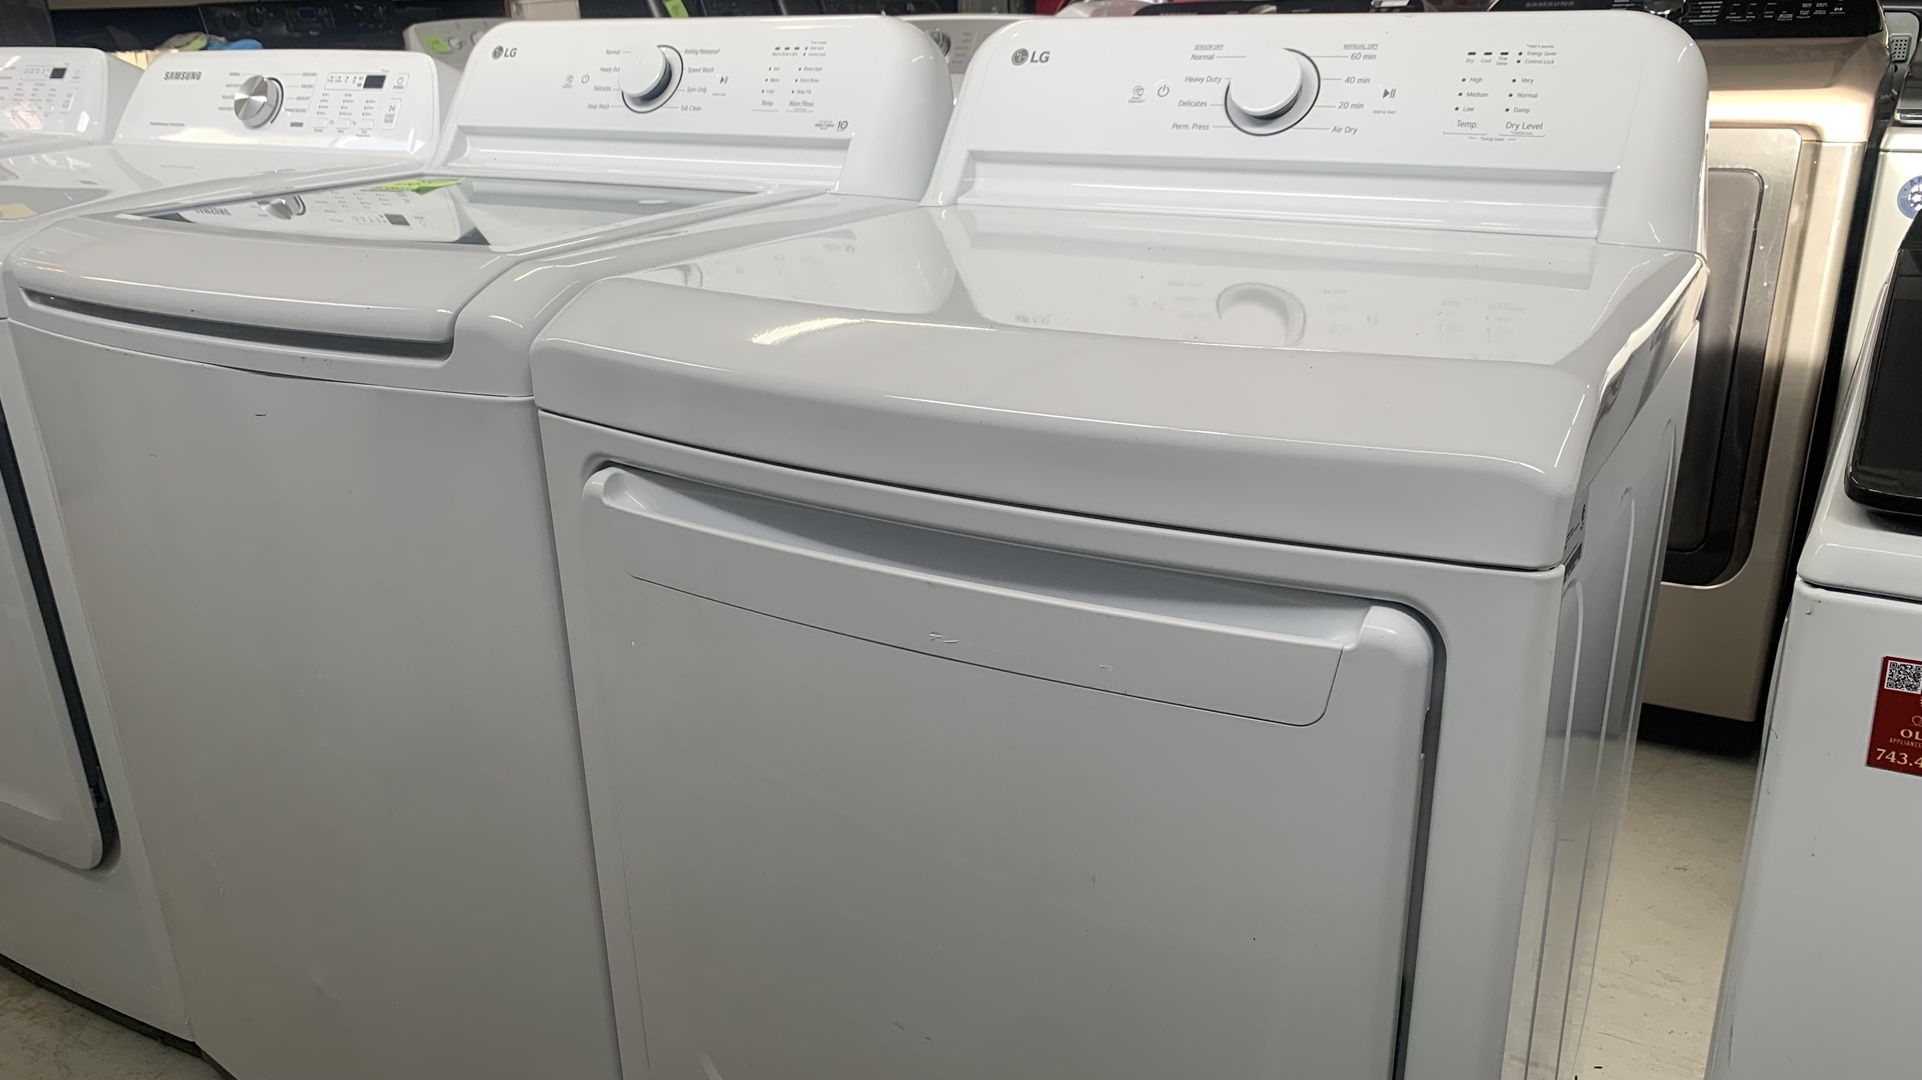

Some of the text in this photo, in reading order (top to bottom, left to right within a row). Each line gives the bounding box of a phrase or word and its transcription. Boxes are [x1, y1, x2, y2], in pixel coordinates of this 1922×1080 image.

[1191, 53, 1215, 61] Normal
[1350, 52, 1362, 60] 60
[163, 71, 202, 81] SAMSUNG
[1184, 76, 1223, 84] Heavy Duty
[1344, 76, 1356, 84] 40
[1521, 77, 1535, 85] Very
[1178, 100, 1208, 108] Delicates
[1338, 101, 1364, 110] 20 min
[1191, 122, 1210, 131] Press
[1456, 120, 1479, 129] Temp.
[1505, 121, 1544, 131] Dry Level
[1344, 126, 1358, 135] Dry
